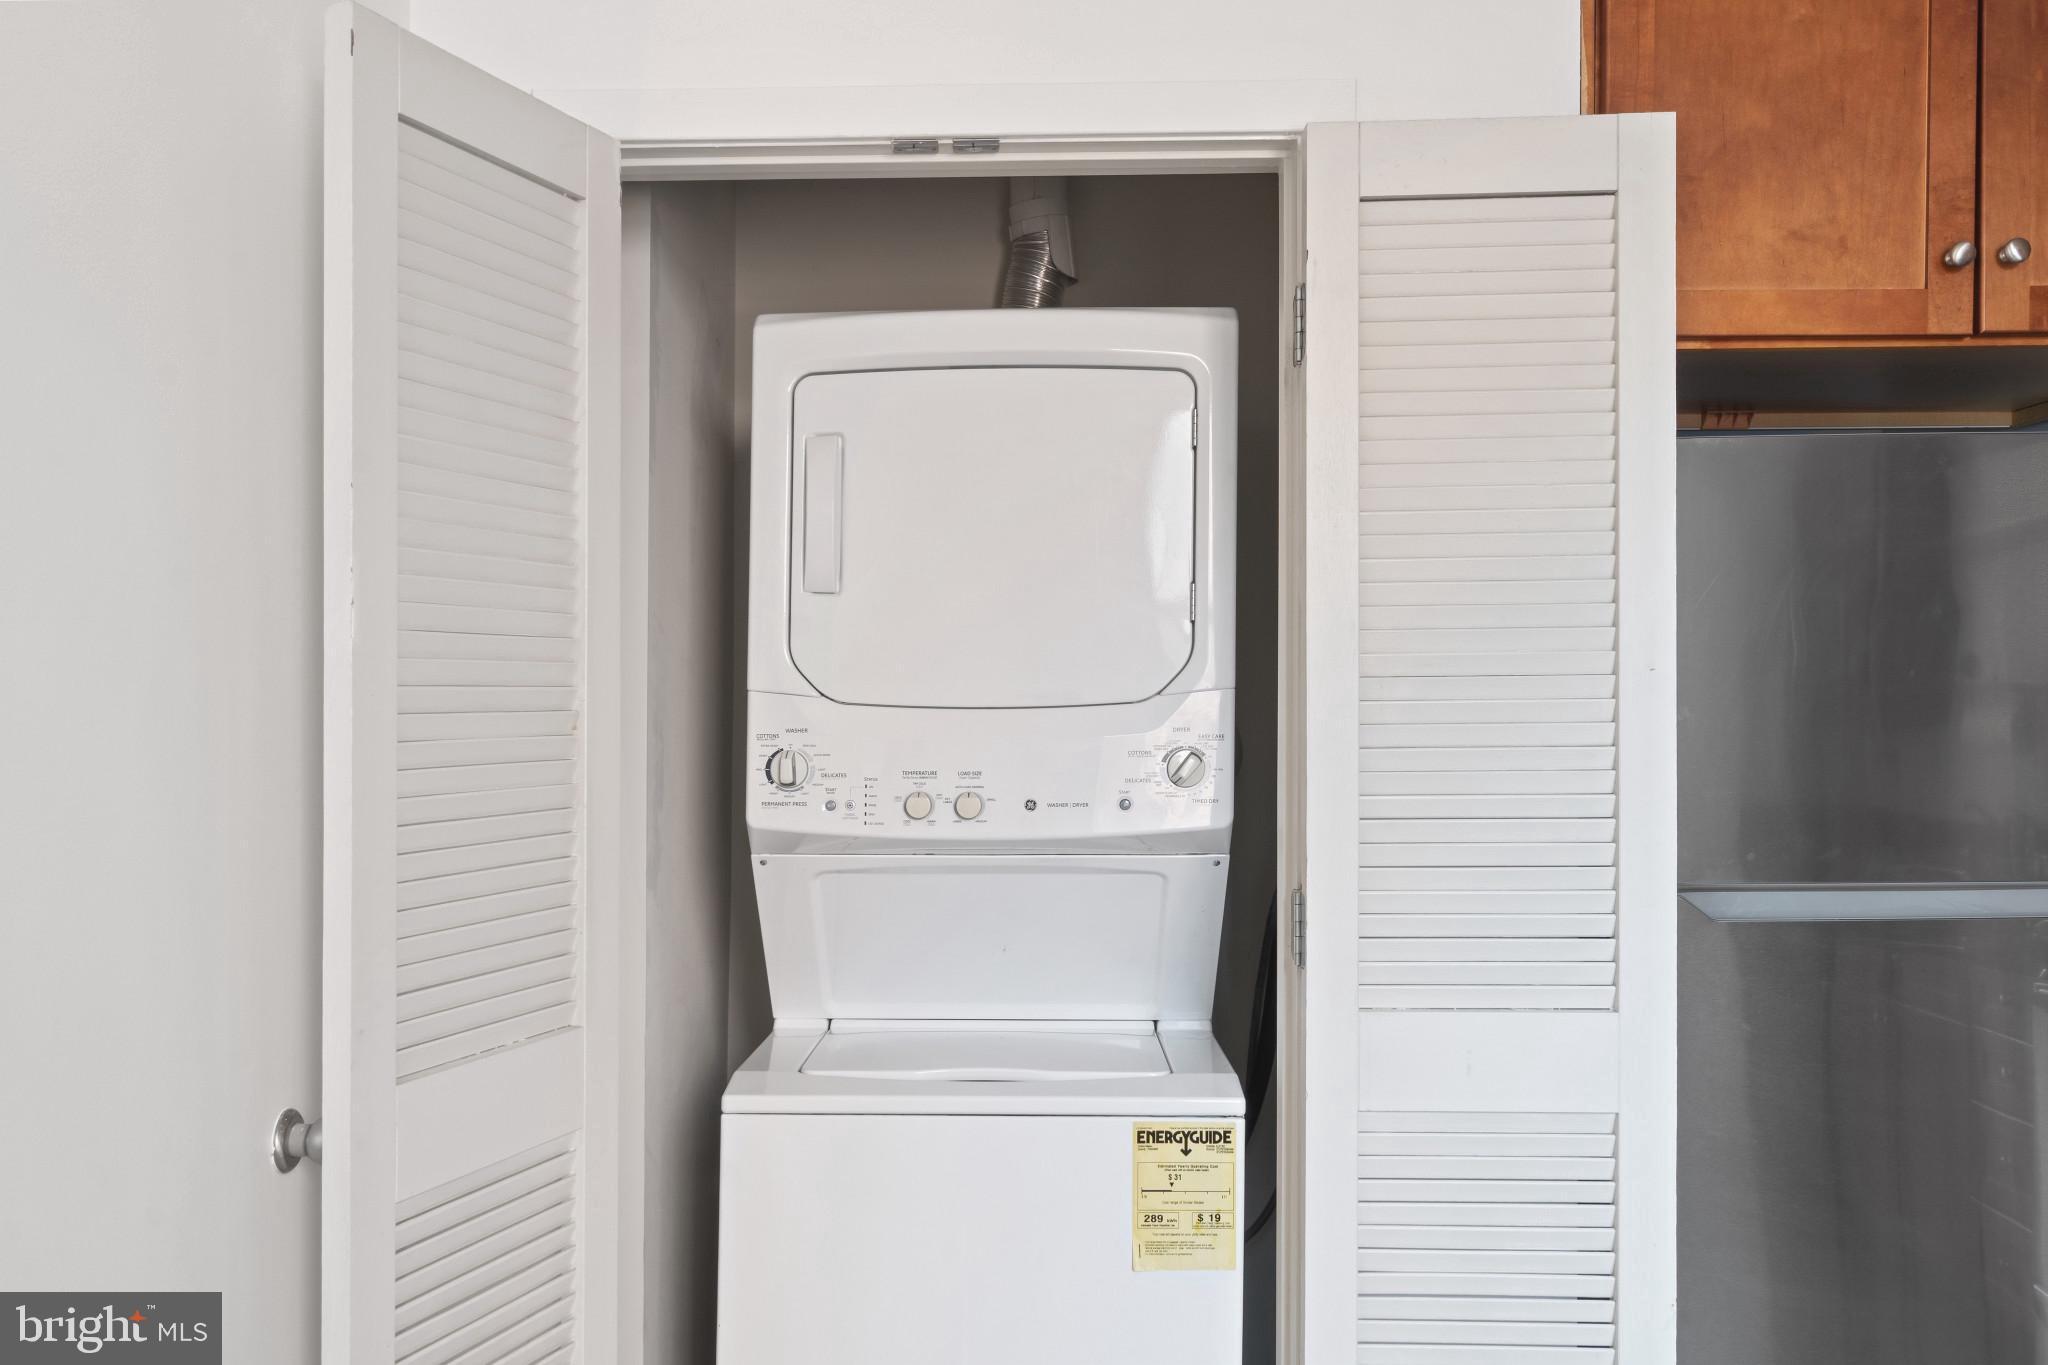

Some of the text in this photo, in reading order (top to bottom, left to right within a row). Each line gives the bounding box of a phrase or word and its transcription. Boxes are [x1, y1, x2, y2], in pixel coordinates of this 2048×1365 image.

[1136, 1130, 1232, 1146] ENERGYGUIDE
[1144, 1214, 1164, 1223] 289
[1197, 1213, 1221, 1222] $ 19
